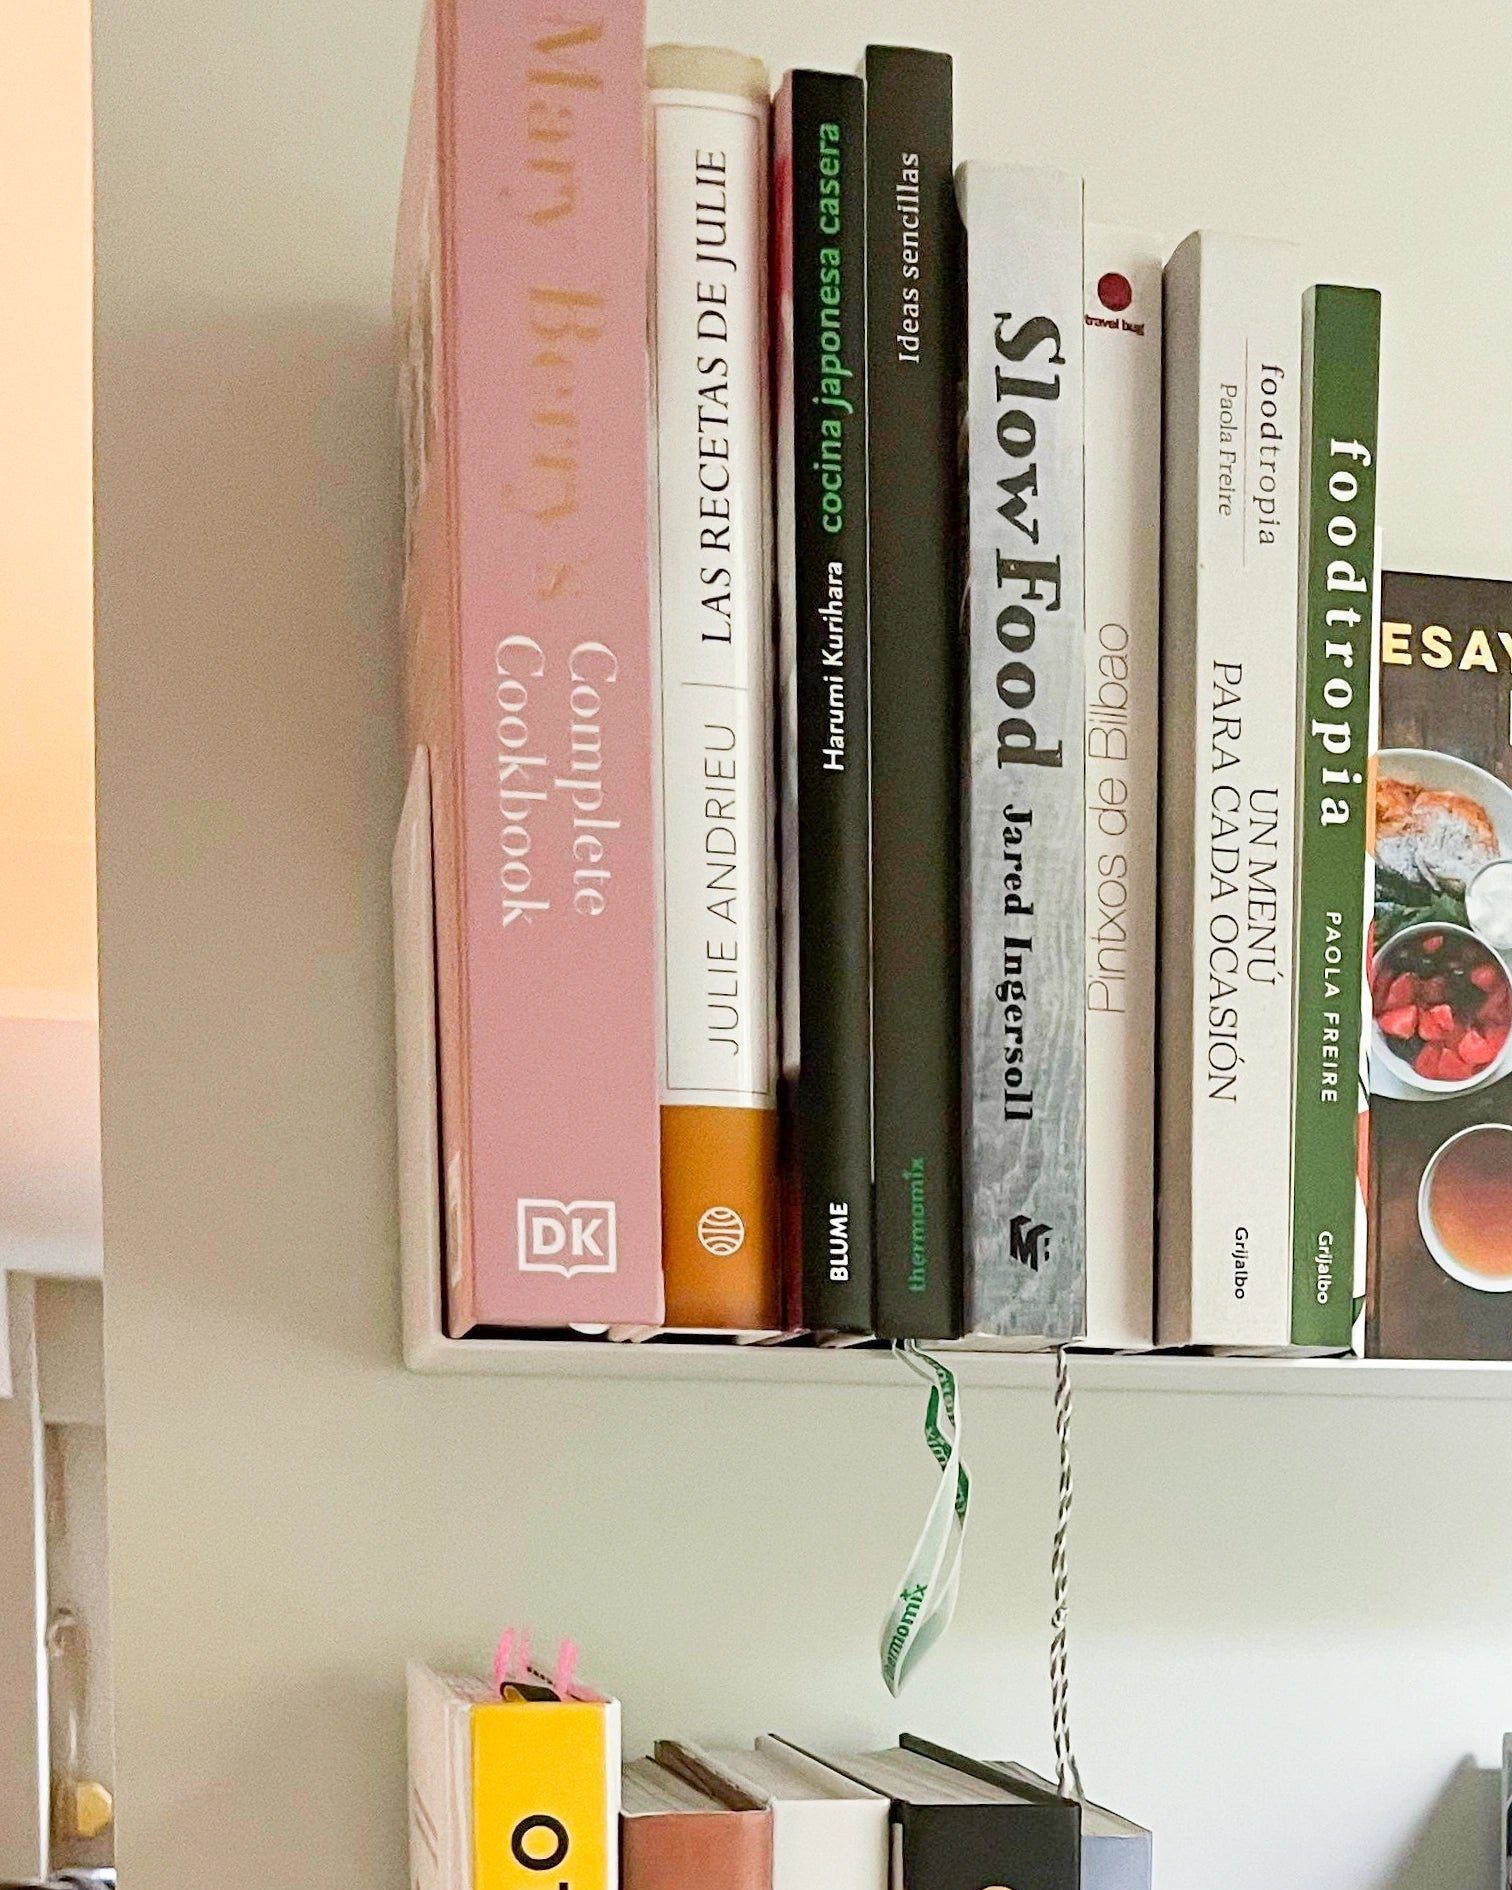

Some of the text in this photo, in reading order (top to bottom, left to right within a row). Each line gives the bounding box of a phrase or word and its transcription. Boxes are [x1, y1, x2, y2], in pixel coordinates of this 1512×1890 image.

[819, 123, 851, 533] cocina japonesa casera
[896, 152, 920, 363] Ideas sencillas
[1085, 314, 1119, 329] travel
[697, 149, 737, 645] LAS RECETAS DE JULIE
[1218, 383, 1238, 517] Paola Freire
[1252, 363, 1285, 544] foodtropia
[994, 312, 1066, 770] Slow Food
[1310, 438, 1371, 827] foodtropia
[820, 560, 845, 771] Harumi Kurihara
[496, 635, 551, 927] Cookbook
[555, 641, 622, 917] Complete
[1089, 622, 1130, 1012] Pintxos de Bilbao
[1208, 659, 1243, 1102] PARA CADA OCASIÓN
[705, 724, 738, 1055] JULIE ANDRIEU
[996, 803, 1033, 1122] Jared Ingersoll
[1245, 789, 1281, 987] UN MENÚ
[1321, 911, 1342, 1103] PAOLA FREIRE
[531, 1215, 605, 1257] DK
[830, 1202, 848, 1281] BLUME
[909, 1157, 924, 1292] thermomix
[1235, 1226, 1248, 1299] Grijalbo
[1316, 1230, 1333, 1304] Grijalbo
